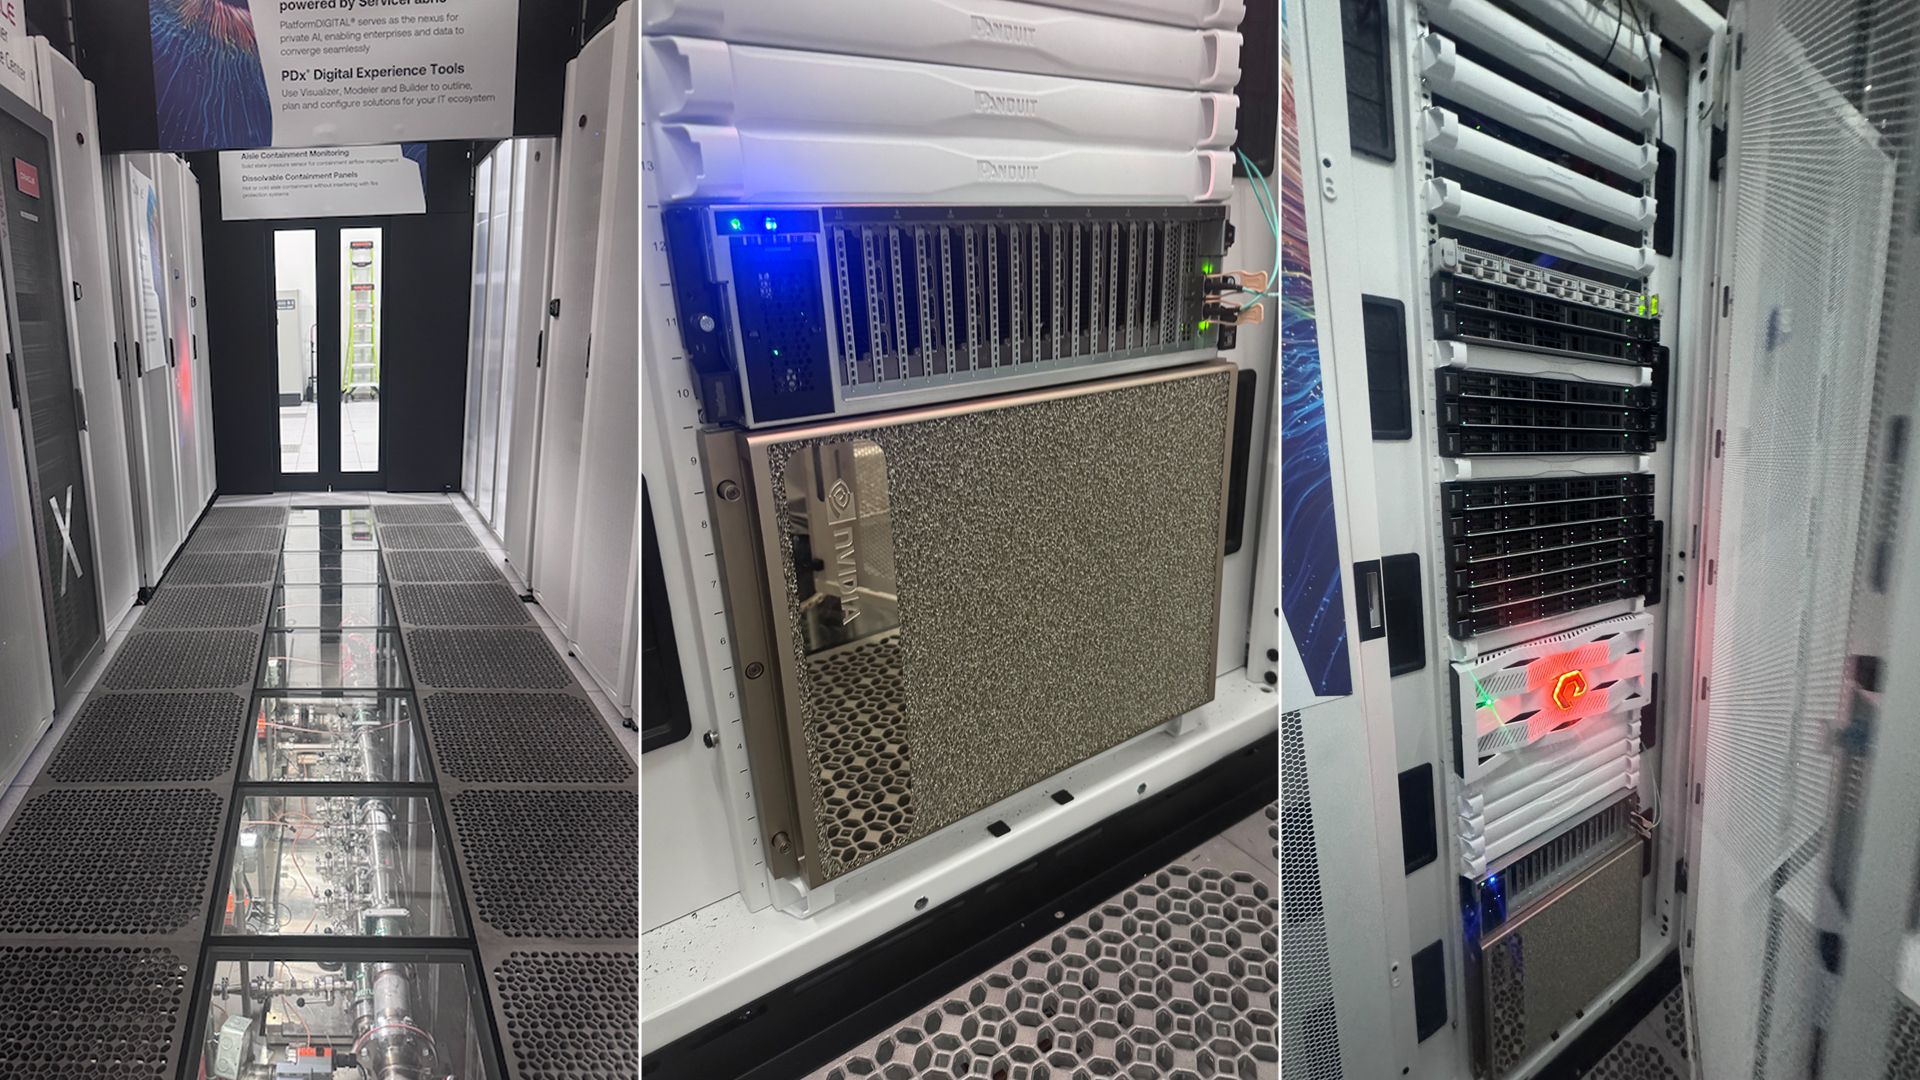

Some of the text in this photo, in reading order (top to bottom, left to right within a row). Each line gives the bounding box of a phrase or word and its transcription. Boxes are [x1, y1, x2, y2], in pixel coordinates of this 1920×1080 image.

[280, 0, 336, 13] powered
[340, 0, 355, 10] by
[358, 17, 387, 26] serves
[401, 15, 416, 24] the
[418, 15, 444, 23] nexus
[446, 13, 460, 22] for
[280, 34, 310, 44] private
[324, 31, 361, 41] enabling
[363, 29, 413, 40] enterprises
[414, 28, 432, 37] and
[433, 27, 454, 36] data
[455, 26, 464, 35] to
[970, 14, 1036, 47] PANDUIT
[280, 44, 370, 57] converge seamlessly
[313, 68, 354, 82] Digital
[356, 65, 427, 80] Experience
[430, 62, 465, 75] Tools
[282, 82, 473, 98] Use Visualizer, Modeler and Builder to outline,
[282, 94, 496, 112] plan and configure solutions for your IT ecosystem
[974, 90, 1038, 117] PANDUIT
[260, 150, 308, 160] Containment
[309, 149, 350, 158] Monitoring
[641, 160, 654, 171] 13
[976, 159, 1039, 182] PANDUIT
[242, 171, 359, 182] Dissolvable Containment Panels
[677, 388, 690, 399] 10
[690, 456, 698, 466] 9
[700, 520, 708, 529] 8
[711, 580, 717, 588] 7
[720, 637, 727, 646] 6
[728, 691, 735, 699] 5
[744, 791, 751, 800] 3
